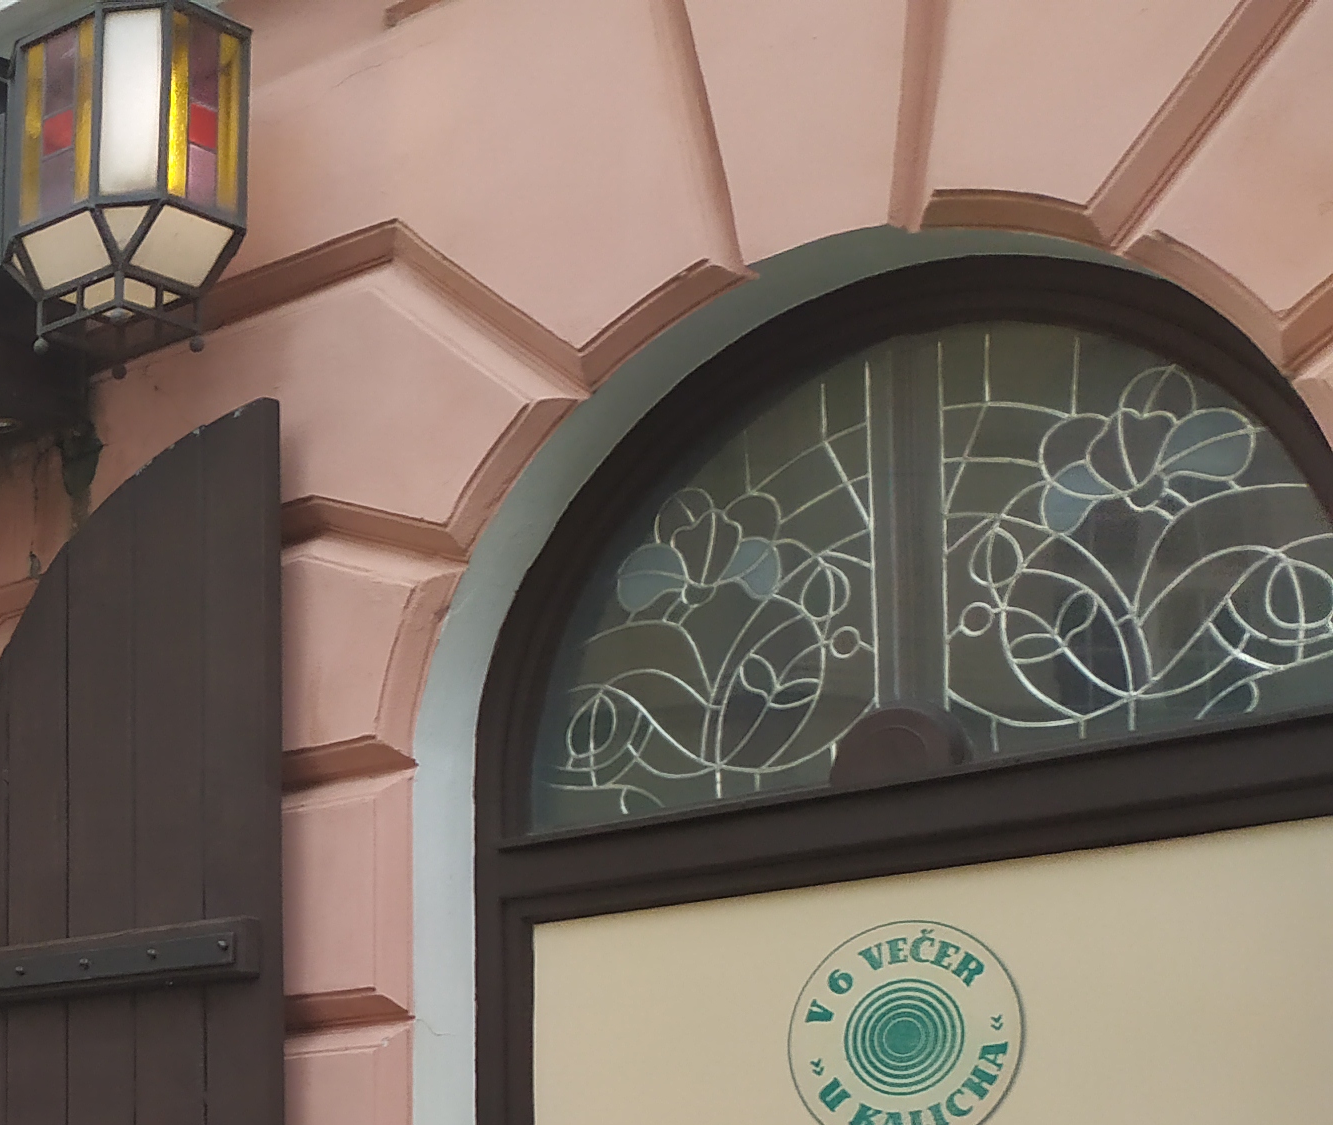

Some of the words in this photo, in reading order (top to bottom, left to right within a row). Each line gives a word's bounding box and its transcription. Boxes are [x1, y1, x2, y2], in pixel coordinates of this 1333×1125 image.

[805, 998, 834, 1023] V
[827, 968, 854, 995] 6
[858, 928, 985, 988] VEČER
[818, 1077, 852, 1112] U
